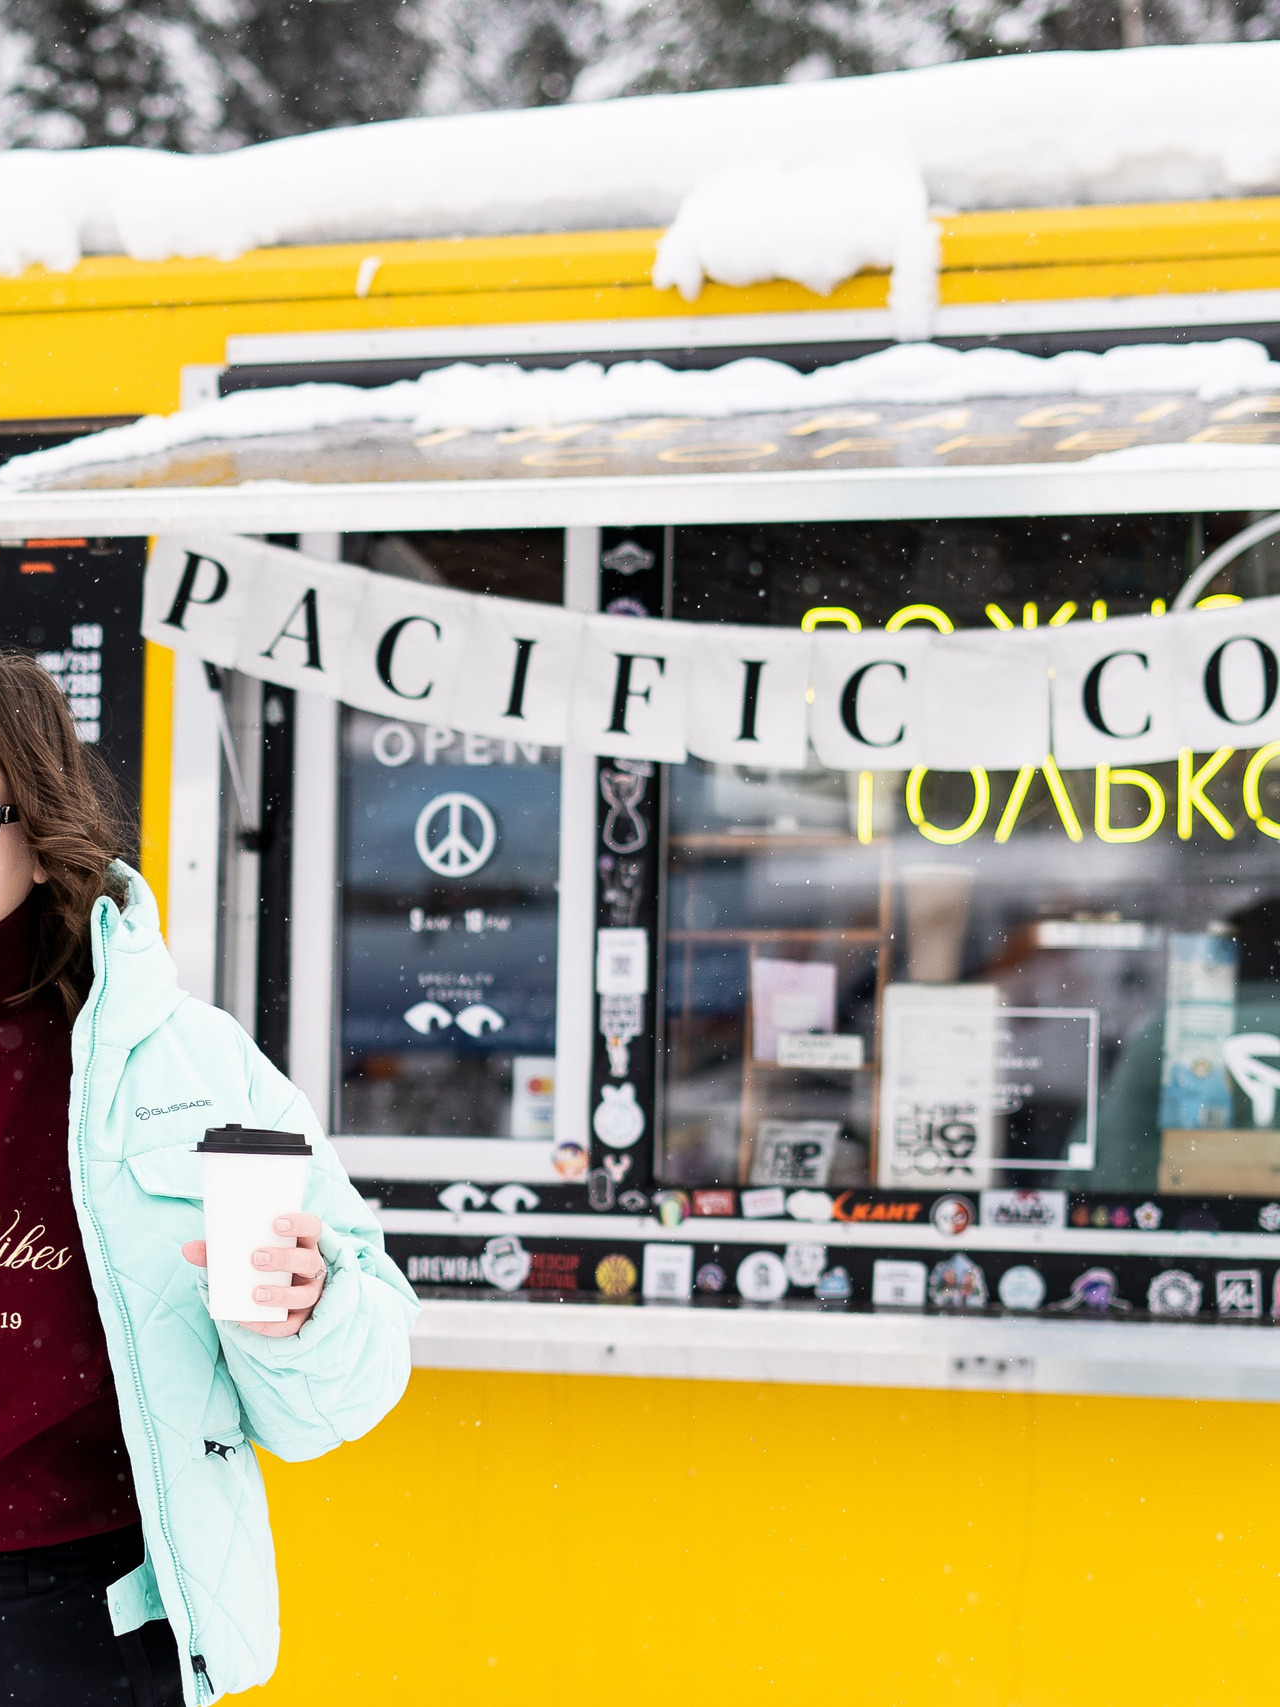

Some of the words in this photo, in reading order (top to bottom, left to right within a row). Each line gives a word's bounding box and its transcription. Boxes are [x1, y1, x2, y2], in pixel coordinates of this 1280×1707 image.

[162, 549, 908, 748] PACIFIC
[1082, 635, 1280, 739] CO
[372, 723, 541, 767] OPEN
[151, 1099, 214, 1117] GLISSADE
